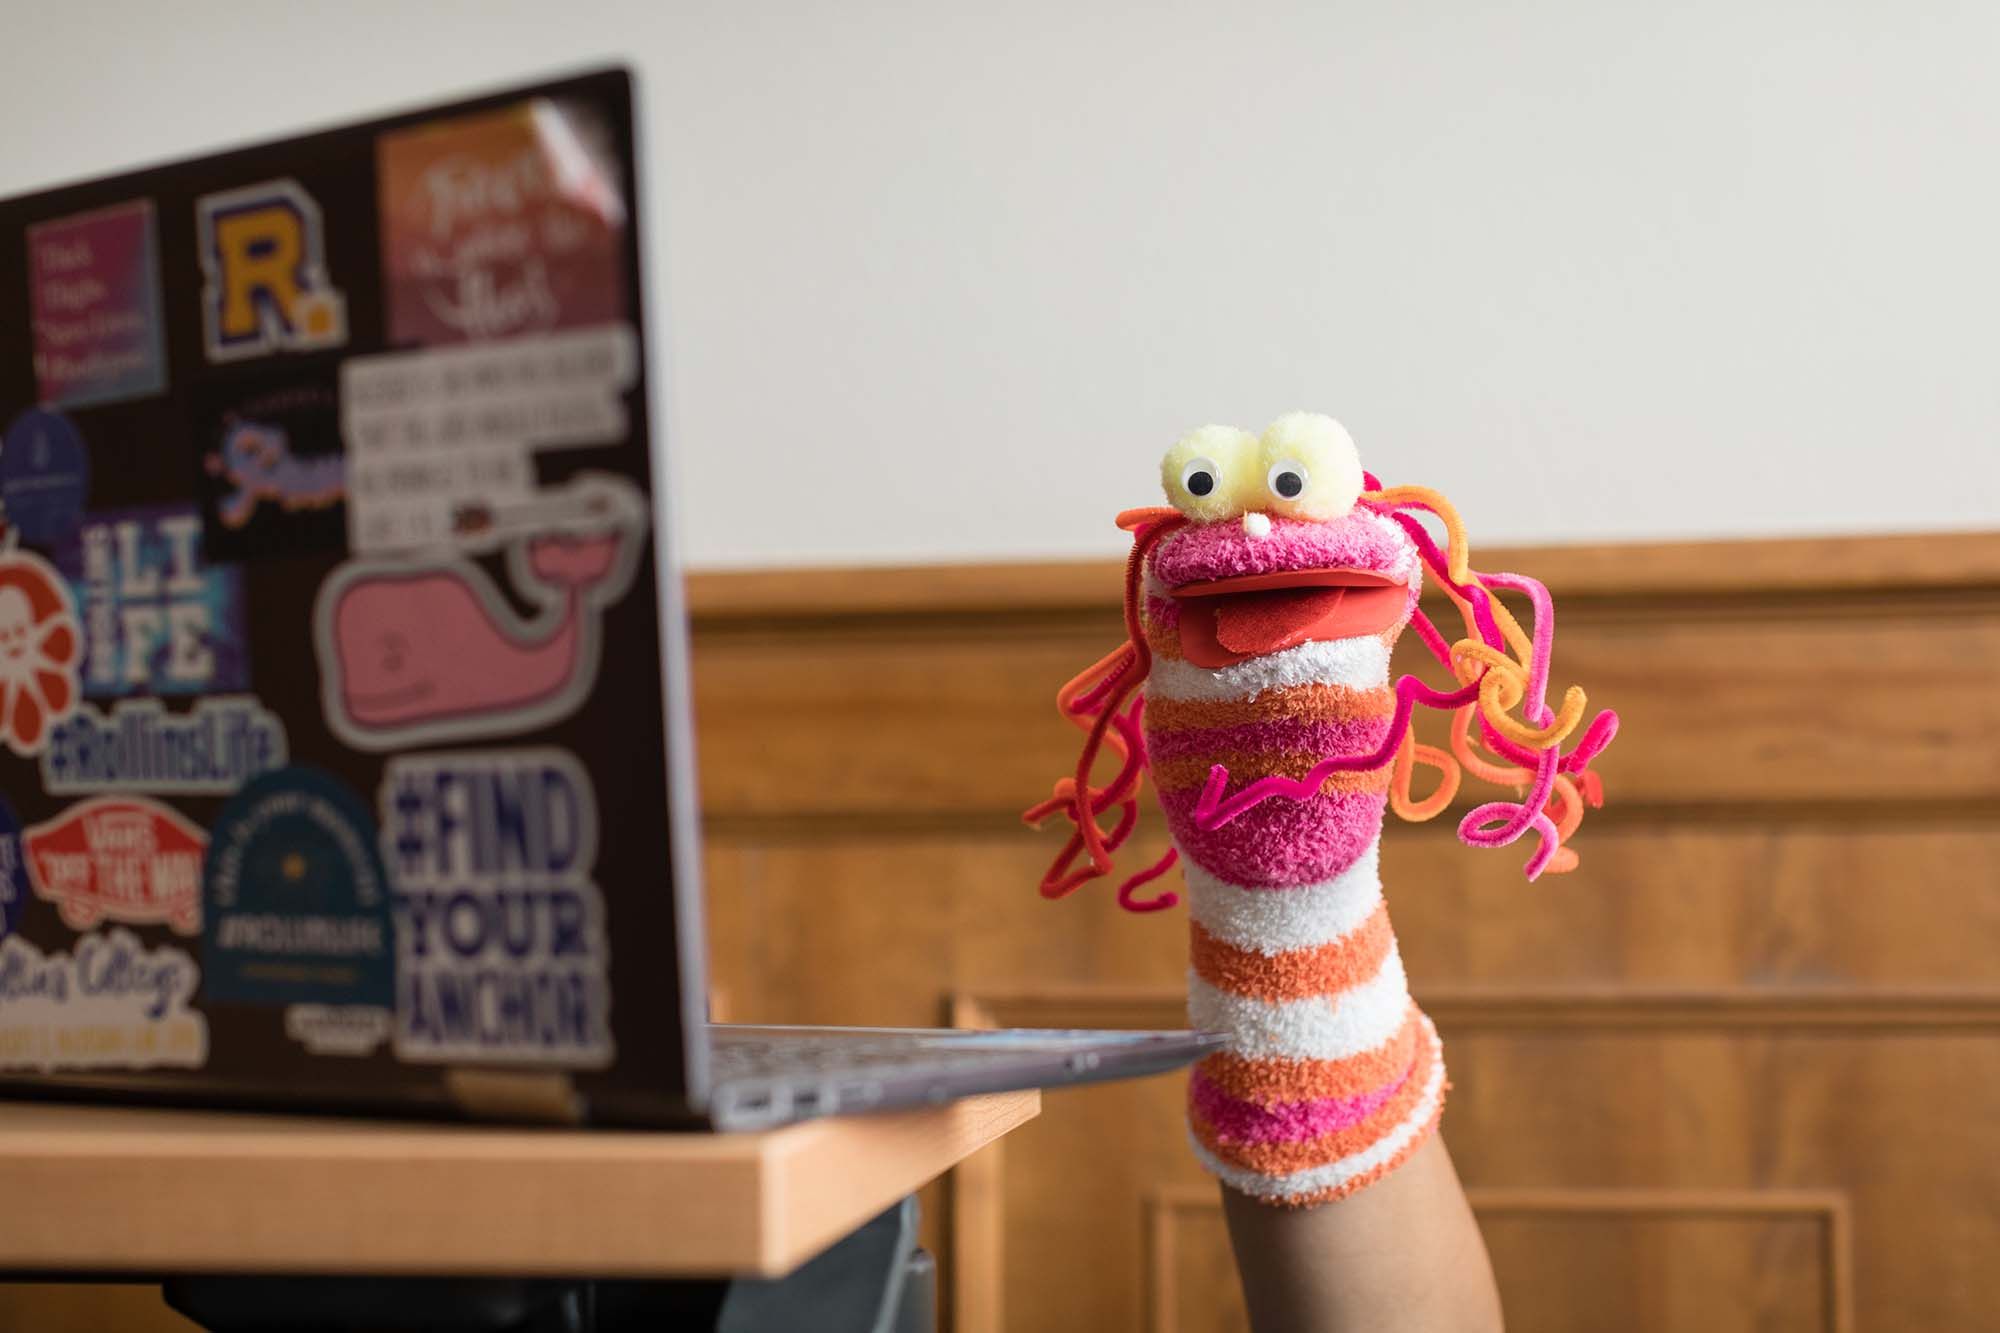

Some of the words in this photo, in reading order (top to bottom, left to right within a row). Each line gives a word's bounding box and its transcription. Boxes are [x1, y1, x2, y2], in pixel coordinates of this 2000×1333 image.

[209, 194, 338, 346] R.
[394, 764, 581, 880] #FIND
[393, 889, 588, 958] YOUR
[408, 968, 593, 1046] ANCHOR
